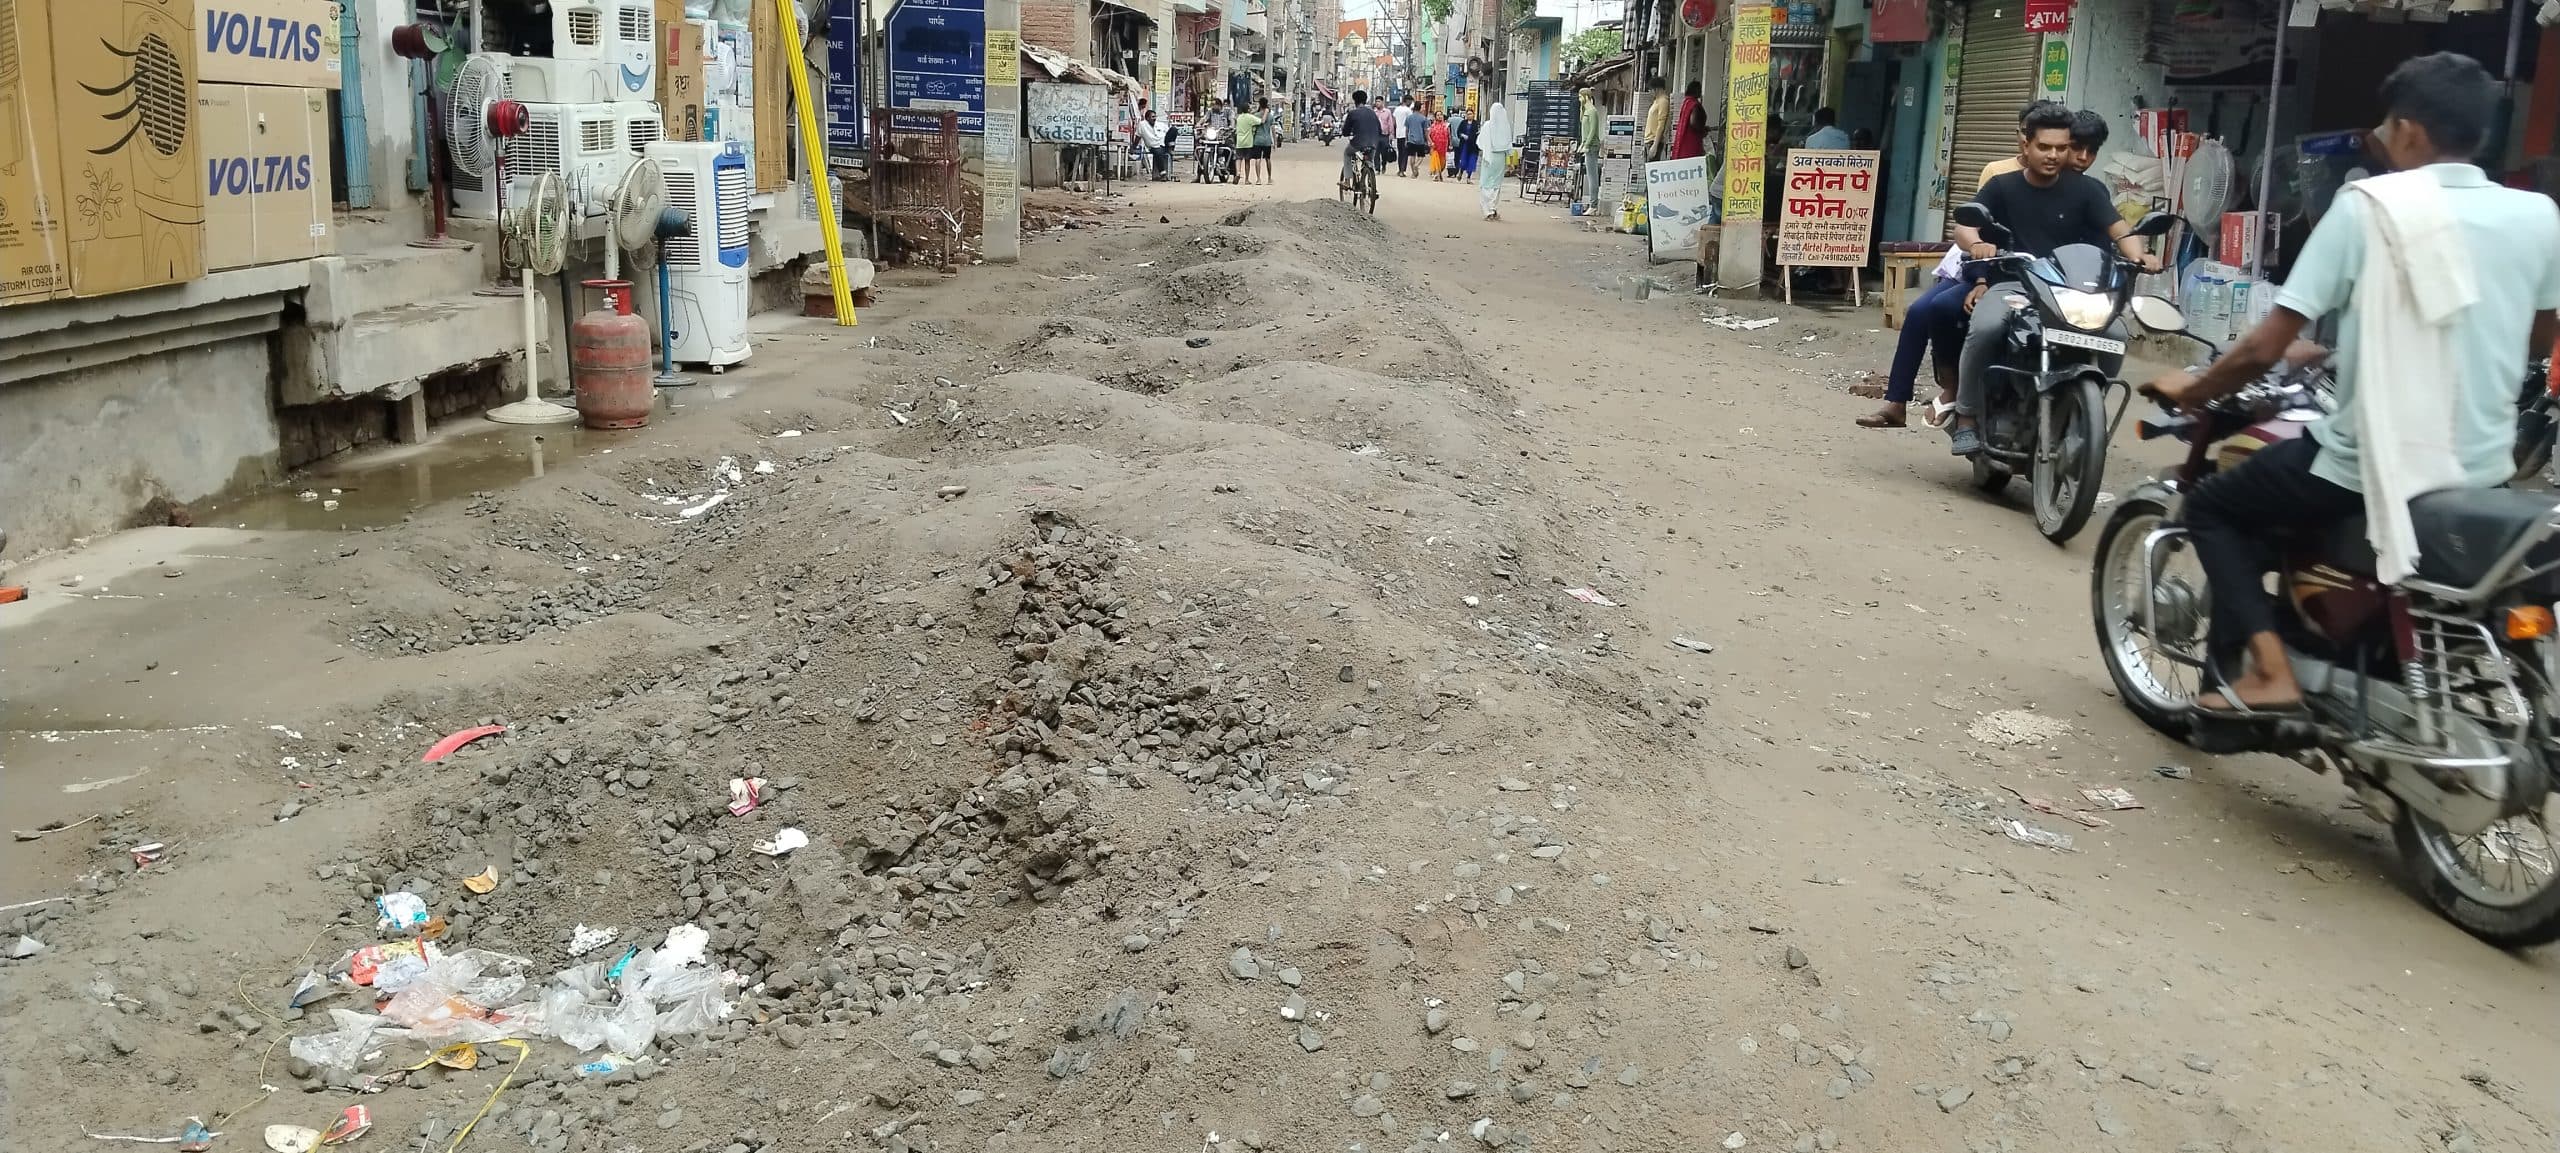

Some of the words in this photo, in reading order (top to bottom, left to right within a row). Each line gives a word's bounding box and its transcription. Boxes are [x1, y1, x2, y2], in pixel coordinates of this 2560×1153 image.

[2030, 11, 2065, 25] ATM
[206, 9, 322, 62] VOLTAS
[917, 55, 927, 64] वार्ड
[957, 117, 982, 126] दनगर
[1731, 119, 1763, 141] लोन
[1032, 125, 1105, 141] KidsEdu
[1731, 154, 1763, 173] फोन
[1792, 156, 1813, 166] अब
[1814, 154, 1846, 167] सबको
[1846, 154, 1874, 168] मिलेगा
[208, 154, 311, 196] VOLTAS
[1649, 165, 1703, 184] Smart
[1790, 167, 1848, 191] लोन
[1850, 169, 1871, 192] पे
[1657, 191, 1677, 199] Foot
[1679, 188, 1700, 198] Step
[1731, 177, 1749, 195] 0%
[1750, 181, 1762, 193] पर
[1788, 193, 1847, 219] फोन
[1858, 207, 1869, 219] पर
[1801, 242, 1823, 252] Airtel
[1824, 243, 1850, 254] Payment
[1850, 243, 1865, 253] Bank
[21, 266, 34, 276] AIR
[34, 264, 61, 274] COOLR
